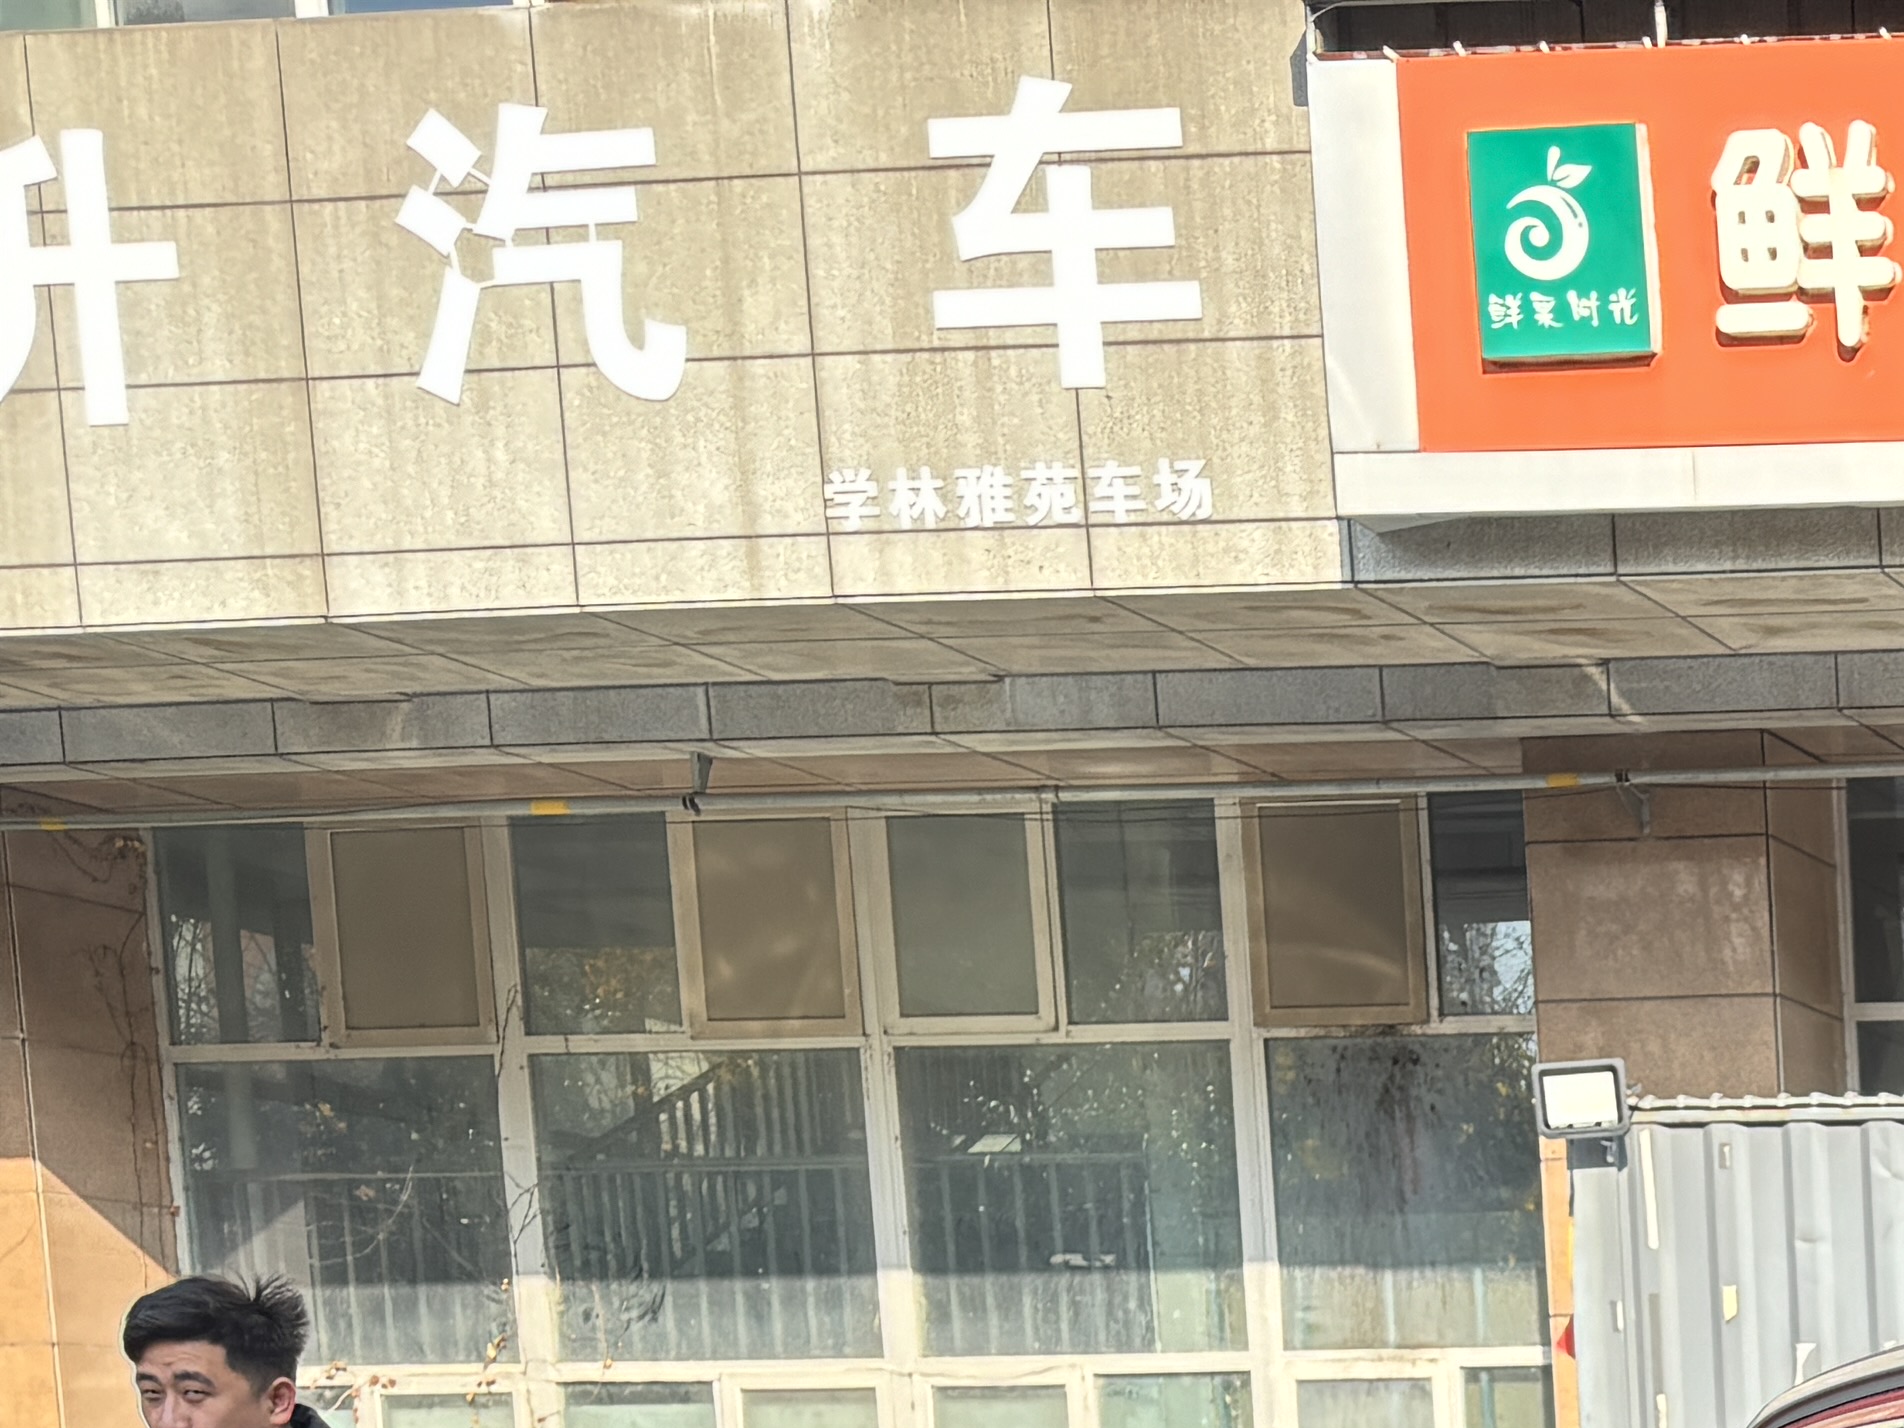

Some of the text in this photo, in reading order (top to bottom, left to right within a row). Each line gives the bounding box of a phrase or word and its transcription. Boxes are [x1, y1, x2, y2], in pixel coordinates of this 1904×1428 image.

[0, 75, 1202, 426] 升汽车
[1487, 287, 1640, 330] 鲜果时光
[823, 458, 1214, 532] 学林雅苑车场
